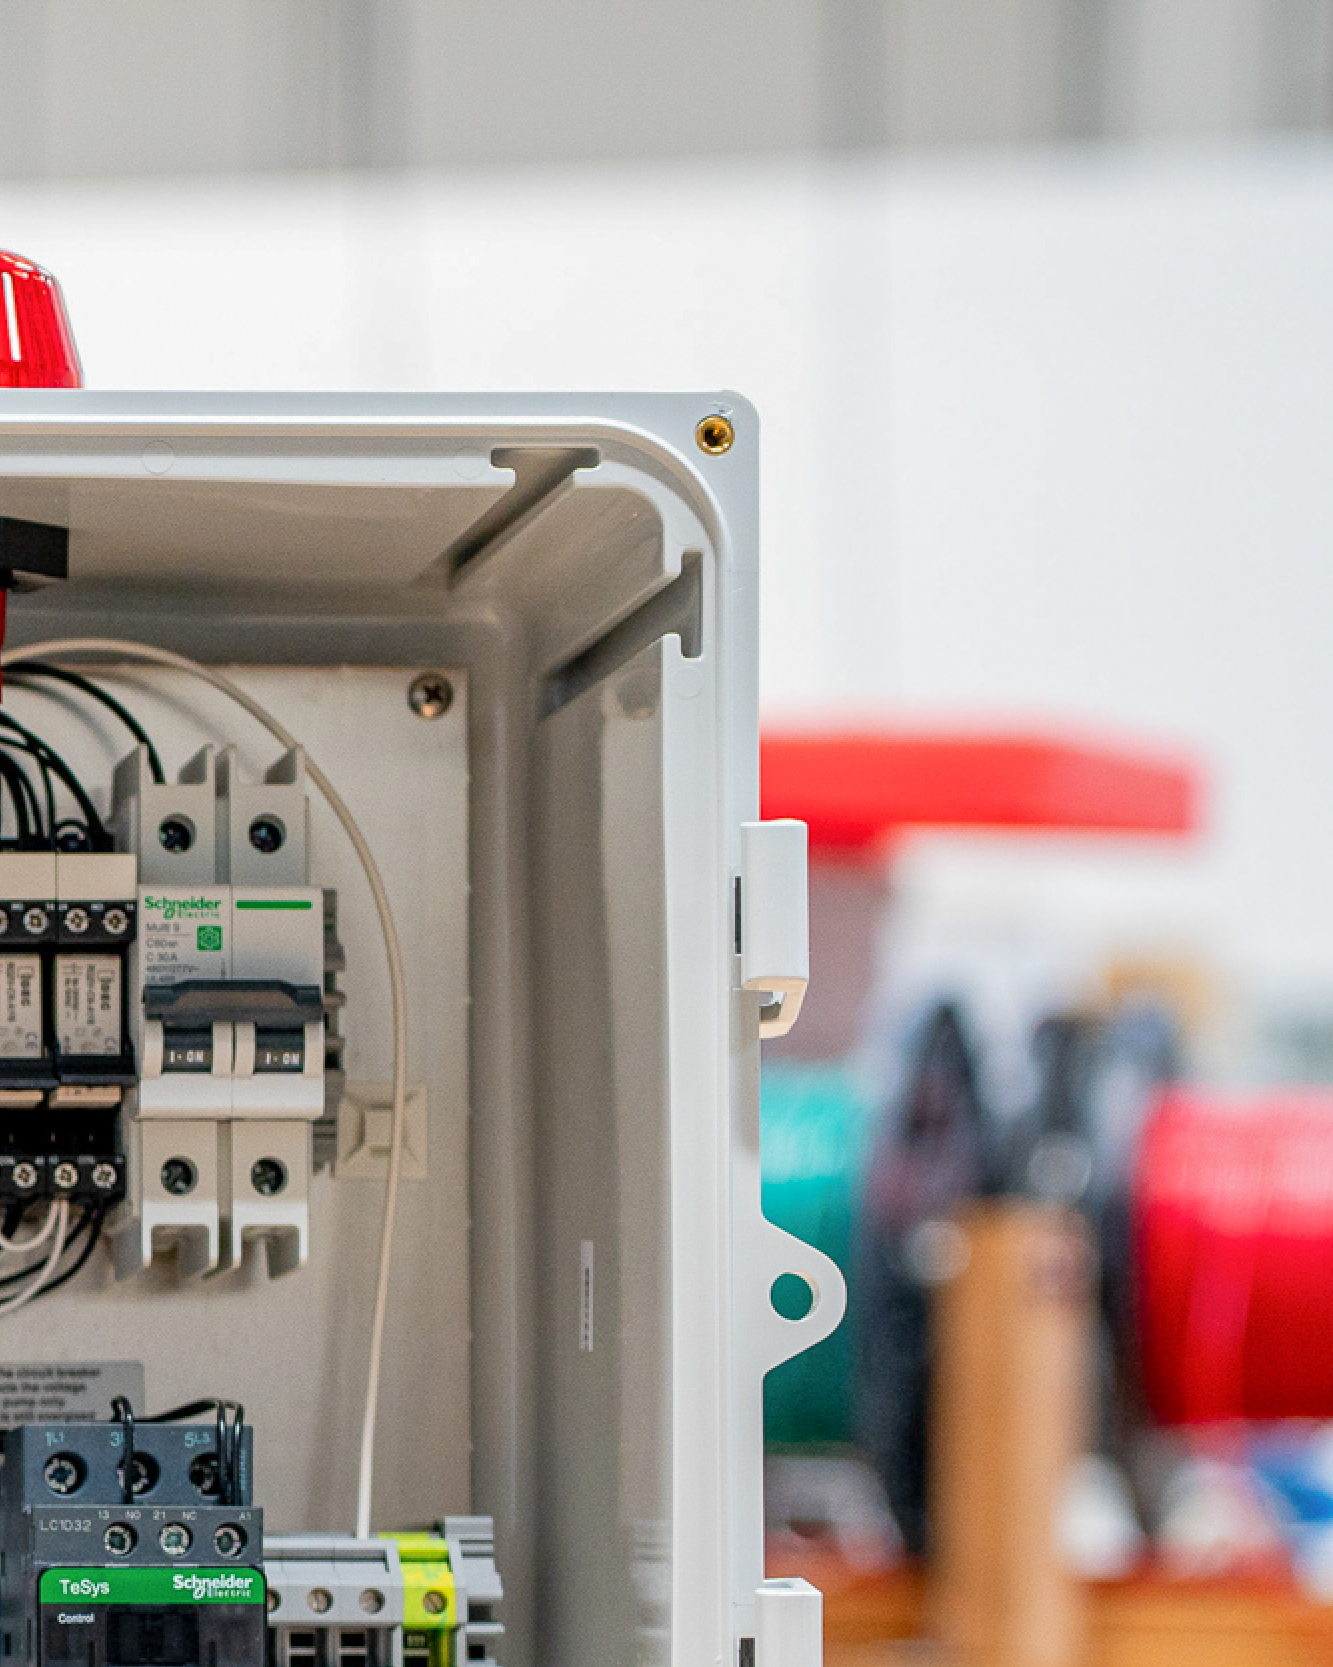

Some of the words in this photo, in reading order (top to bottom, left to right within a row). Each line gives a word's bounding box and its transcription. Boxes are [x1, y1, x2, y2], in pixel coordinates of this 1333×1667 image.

[144, 896, 222, 920] Schneider
[97, 1510, 111, 1521] 13
[152, 1510, 167, 1521] 21
[181, 1511, 197, 1521] NC
[238, 1511, 253, 1521] A1
[58, 1578, 111, 1599] TeSys
[171, 1573, 254, 1600] Schneider
[56, 1612, 97, 1626] Control
